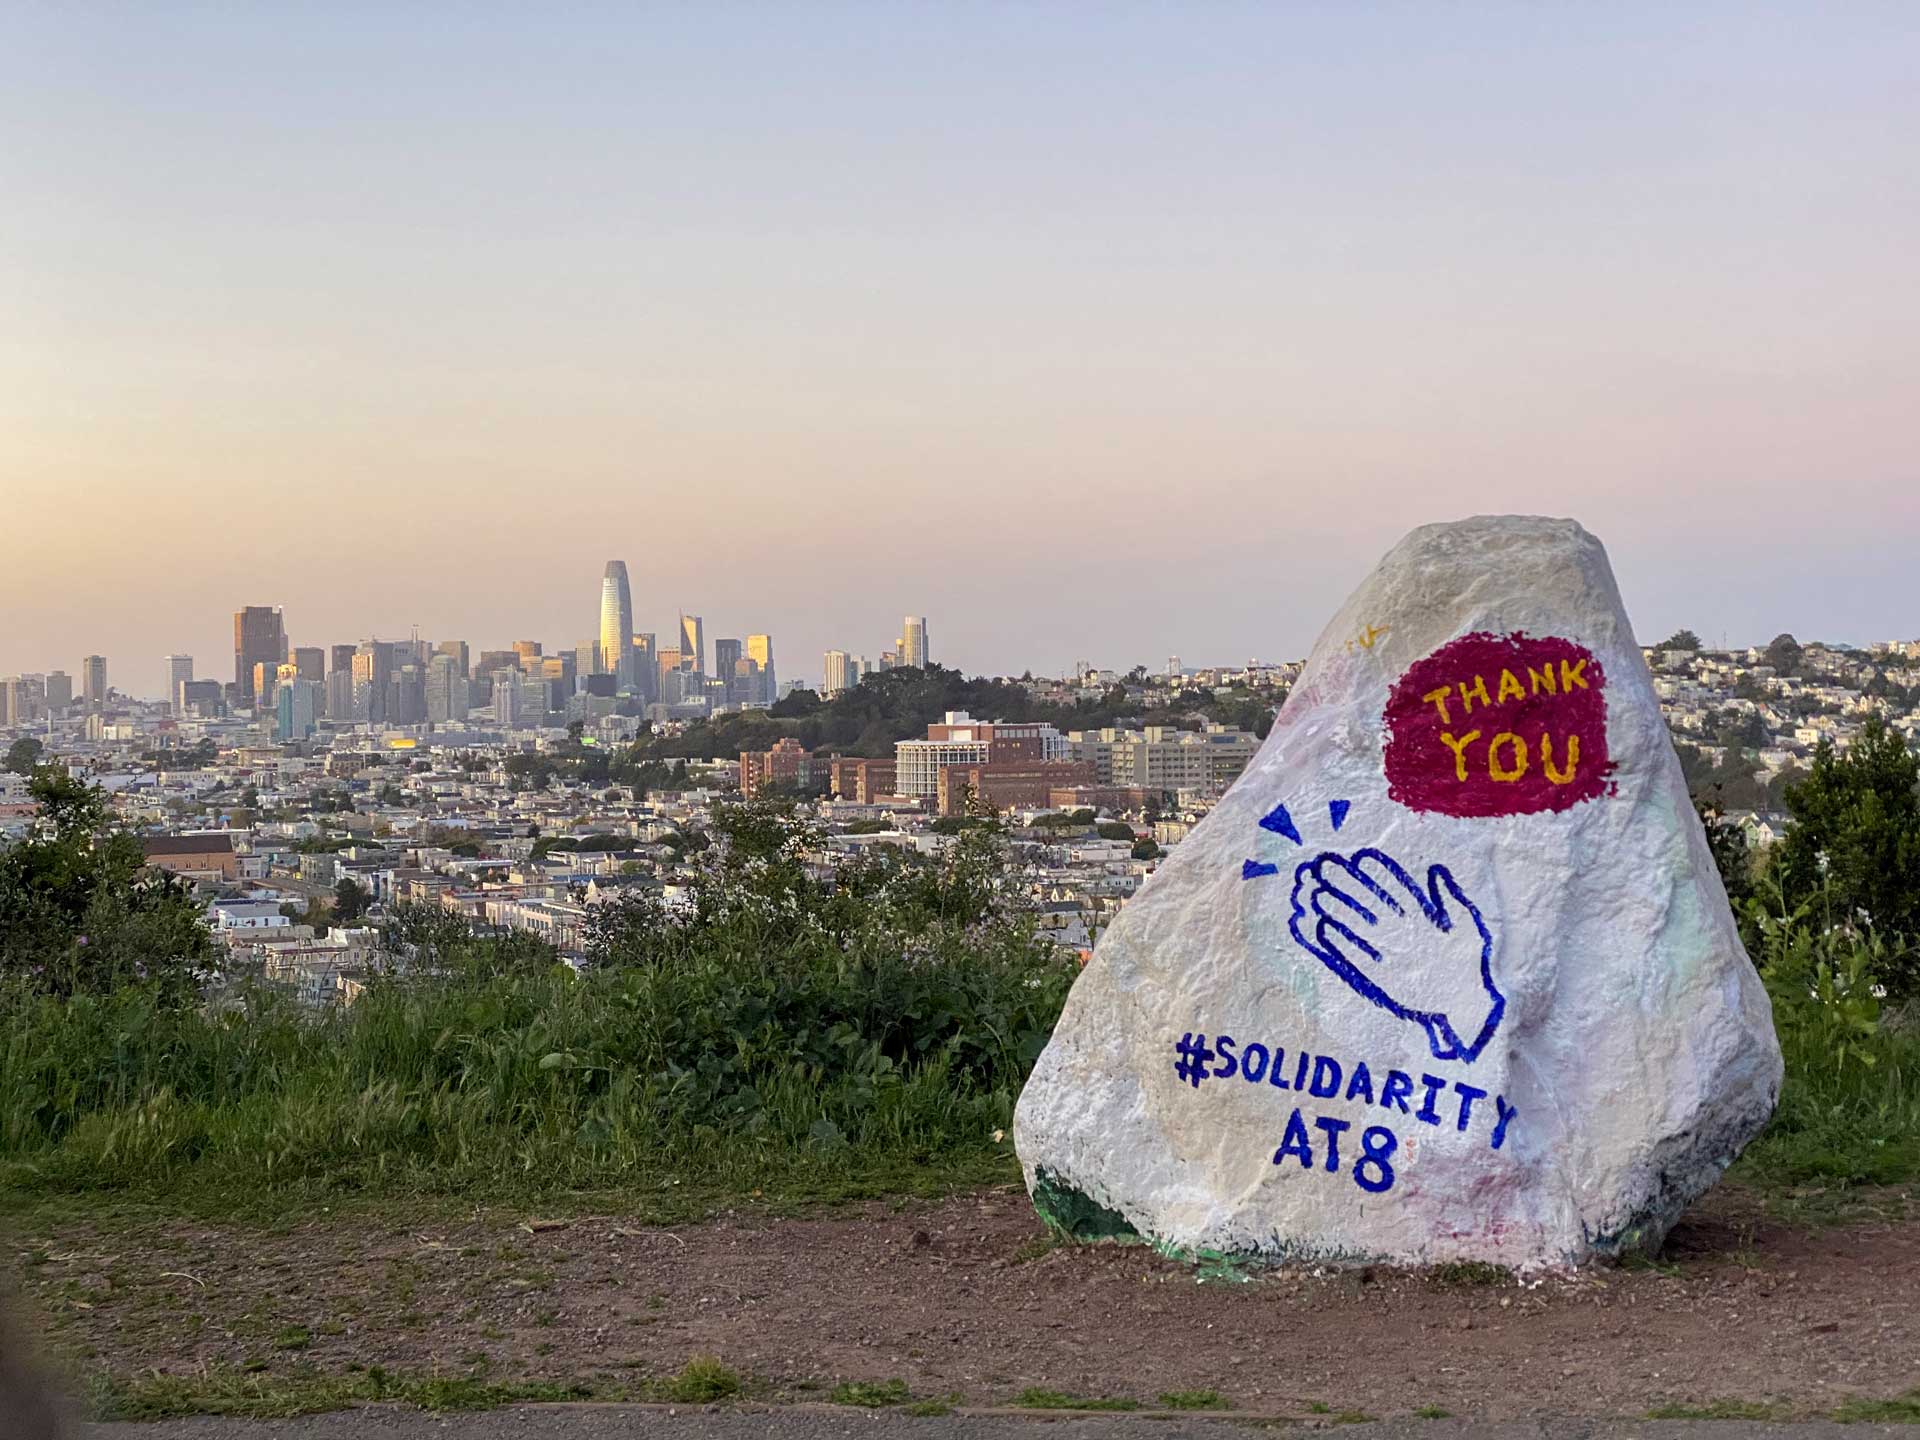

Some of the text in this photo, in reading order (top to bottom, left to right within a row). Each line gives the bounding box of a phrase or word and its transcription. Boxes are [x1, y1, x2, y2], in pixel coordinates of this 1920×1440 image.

[1423, 658, 1588, 724] THANK
[1439, 729, 1580, 785] YOU
[1174, 1032, 1519, 1150] #SOLIDARITY
